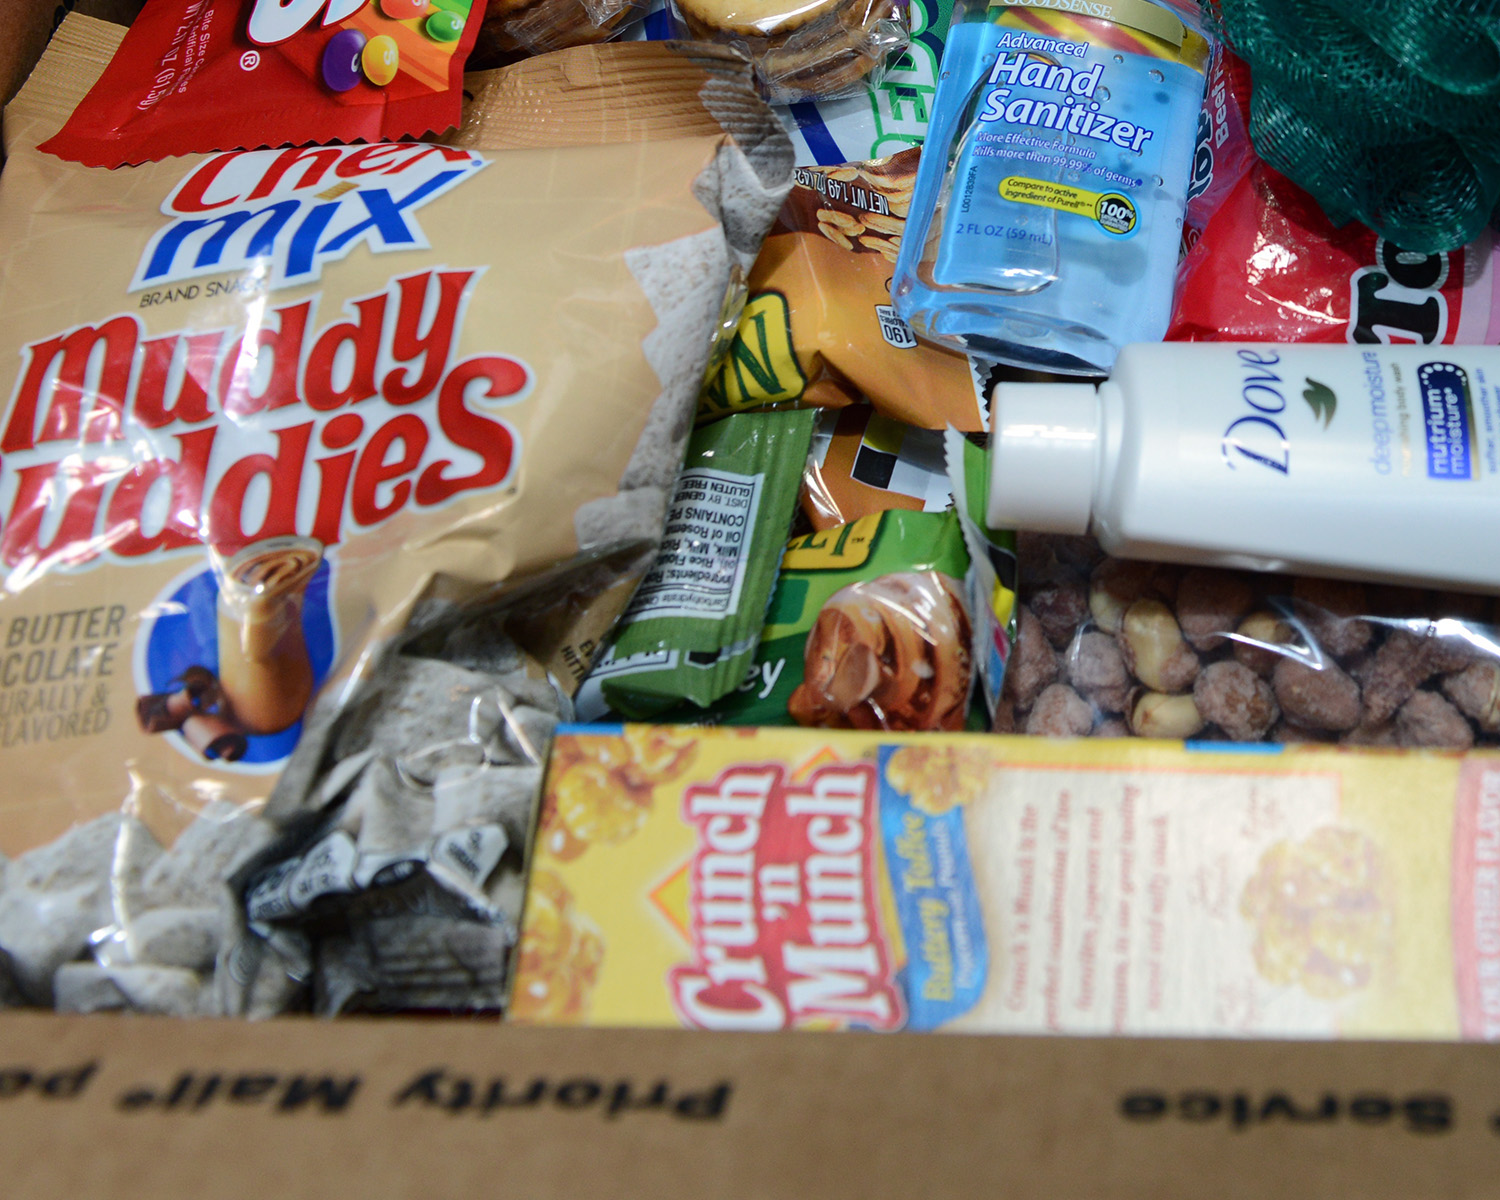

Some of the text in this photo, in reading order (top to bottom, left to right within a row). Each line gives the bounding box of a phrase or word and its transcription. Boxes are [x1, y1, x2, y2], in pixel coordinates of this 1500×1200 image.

[997, 32, 1089, 58] Advanced
[987, 52, 1105, 98] Hand
[980, 89, 1154, 153] Sanitizer
[975, 131, 1098, 160] More Effective Formula
[972, 146, 1106, 176] Kills more than 99.99% of
[850, 186, 890, 215] NET WT
[1004, 189, 1048, 204] ingredient
[1007, 178, 1078, 199] Compare active
[1100, 201, 1134, 220] 100%
[967, 224, 1053, 246] FL OZ (59 mL)
[138, 283, 200, 309] BRAND
[883, 324, 912, 345] 190
[1221, 349, 1290, 475] Dove
[1428, 388, 1448, 475] nutrium
[682, 480, 750, 498] GLUTEN FREE
[685, 507, 745, 527] CONTAINS
[8, 604, 126, 647] BUTTER
[680, 765, 788, 1030] Crunch
[782, 767, 892, 1022] Munch
[396, 1066, 737, 1120] Priority
[1117, 1087, 1456, 1134] Service
